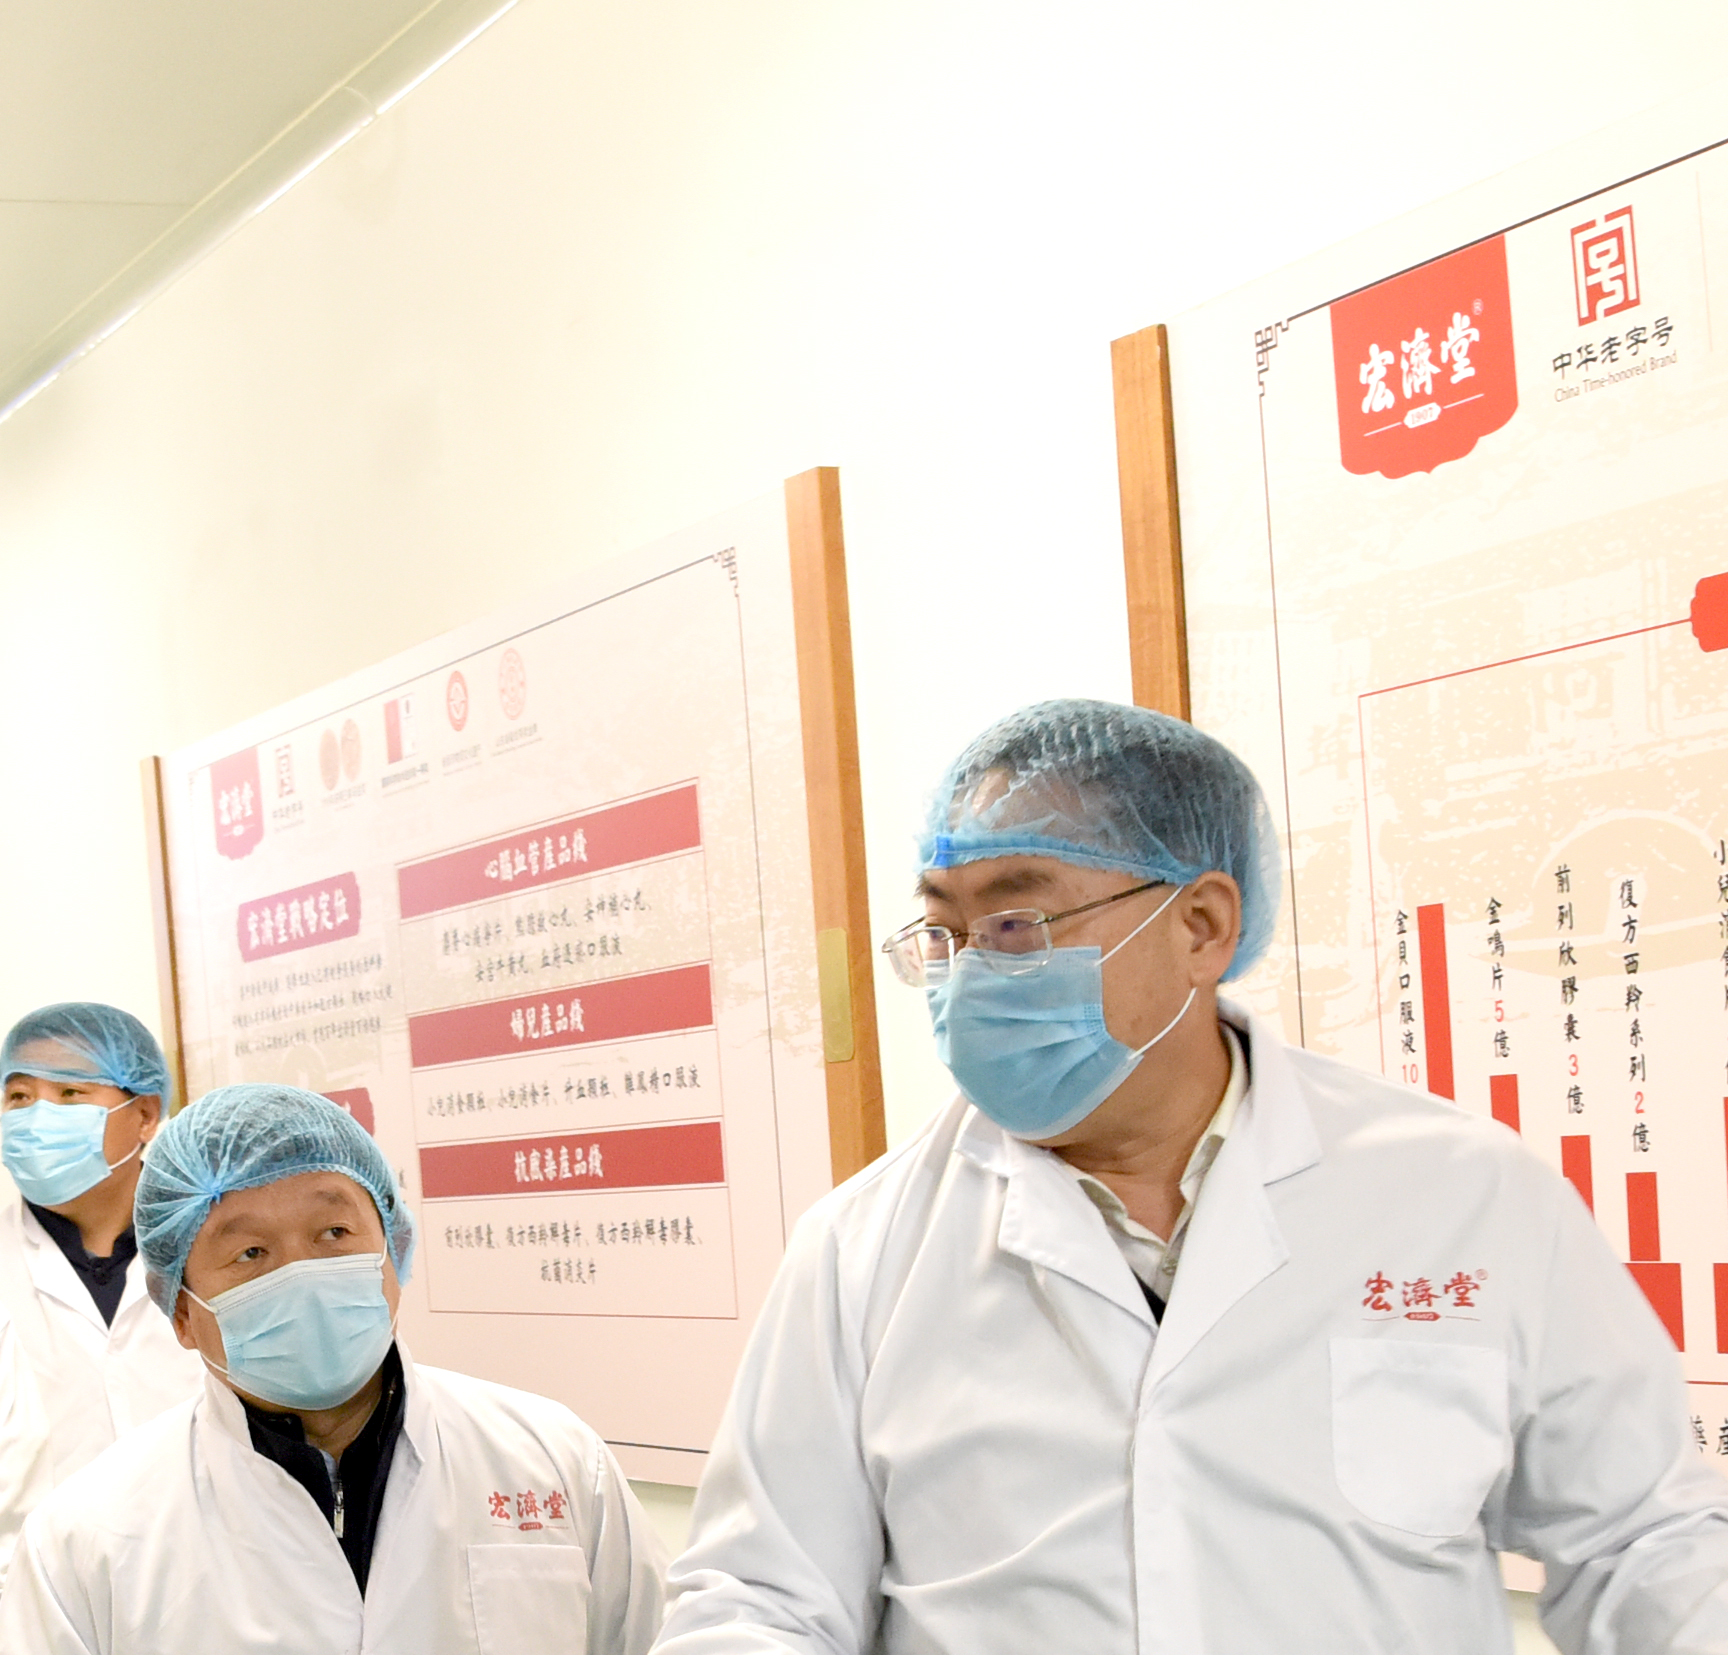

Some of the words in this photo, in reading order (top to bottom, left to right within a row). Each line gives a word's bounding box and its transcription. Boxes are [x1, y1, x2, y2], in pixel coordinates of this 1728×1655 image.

[1552, 315, 1674, 380] 中华老字号
[1553, 385, 1581, 403] China
[1582, 359, 1648, 393] Time-honored
[1649, 348, 1678, 371] Brand
